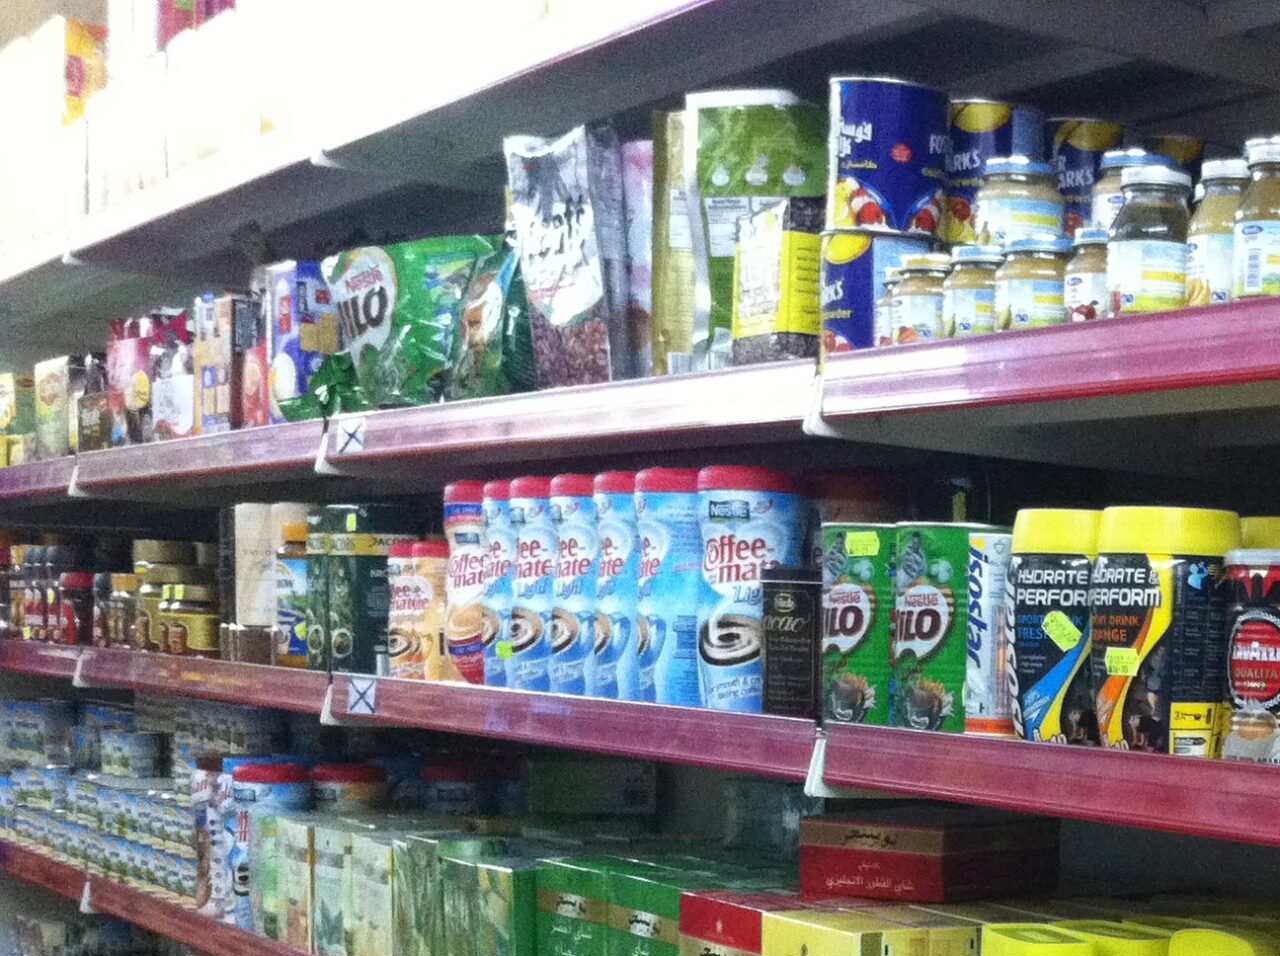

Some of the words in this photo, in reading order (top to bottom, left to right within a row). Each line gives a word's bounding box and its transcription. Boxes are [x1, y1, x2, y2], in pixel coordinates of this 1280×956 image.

[335, 284, 389, 342] ILO
[1018, 569, 1090, 586] HYDRATE
[732, 585, 762, 606] Lig
[1016, 588, 1090, 607] PERFOR
[1018, 628, 1049, 641] FRES
